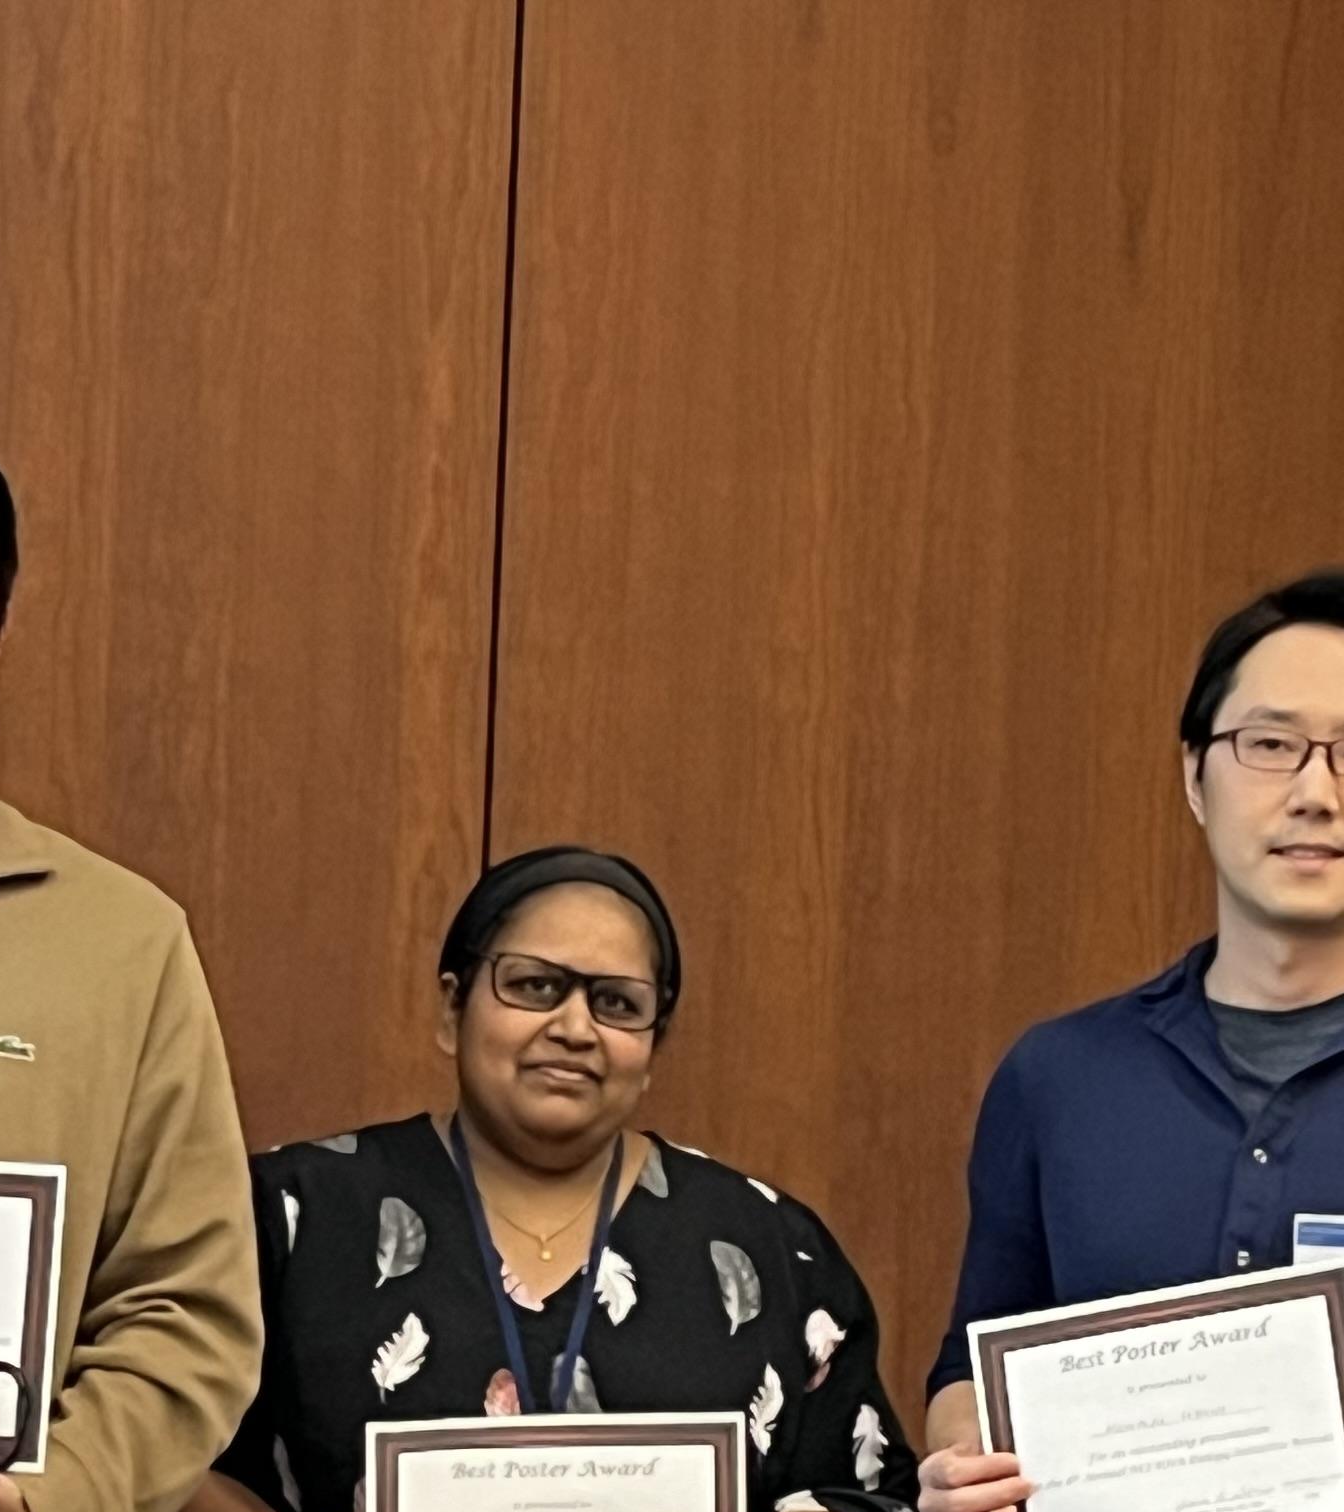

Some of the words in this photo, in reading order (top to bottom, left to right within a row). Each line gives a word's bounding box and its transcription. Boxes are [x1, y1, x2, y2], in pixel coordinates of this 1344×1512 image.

[1059, 1351, 1105, 1374] Best
[1111, 1337, 1182, 1364] Poster
[1188, 1316, 1273, 1351] Award
[451, 1460, 497, 1480] Best
[503, 1459, 571, 1479] Poster
[577, 1456, 661, 1478] Award
